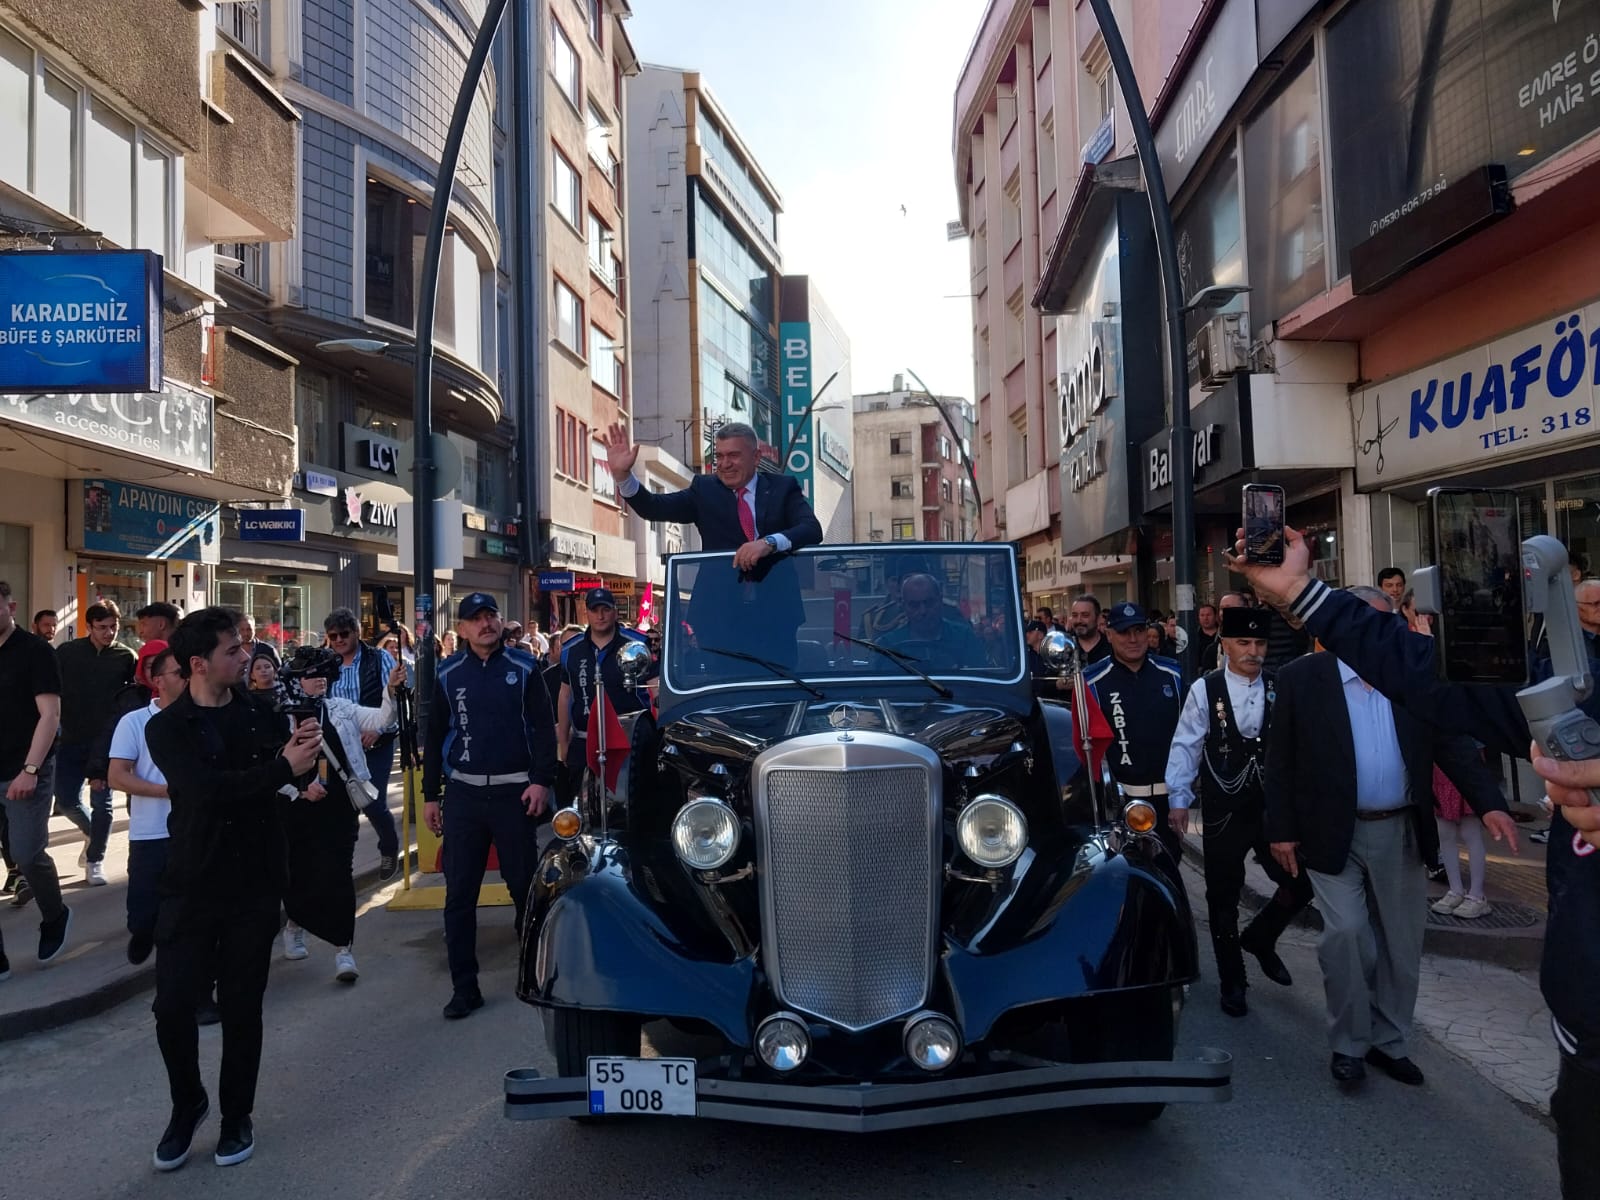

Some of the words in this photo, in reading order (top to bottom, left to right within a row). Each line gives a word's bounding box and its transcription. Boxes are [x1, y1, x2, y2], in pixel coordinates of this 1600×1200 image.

[1518, 51, 1577, 108] EMRE
[1583, 32, 1600, 64] Ö
[1175, 56, 1216, 163] EMRE
[11, 297, 128, 322] KARADENİZ
[0, 327, 37, 345] BÜFE
[42, 329, 52, 344] &
[56, 324, 141, 347] ŞARKÜTERİ
[1409, 314, 1600, 440] KUAFÖ
[54, 410, 161, 452] accessories
[1479, 427, 1529, 449] TEL:
[1541, 407, 1591, 434] 318
[118, 486, 182, 517] APAYDIN
[245, 521, 258, 530] LC
[1028, 548, 1057, 586] imaj
[1109, 692, 1132, 765] ZABITA
[596, 1062, 625, 1083] 55
[661, 1064, 688, 1085] TC
[592, 1104, 602, 1112] TR
[620, 1089, 663, 1111] 008
